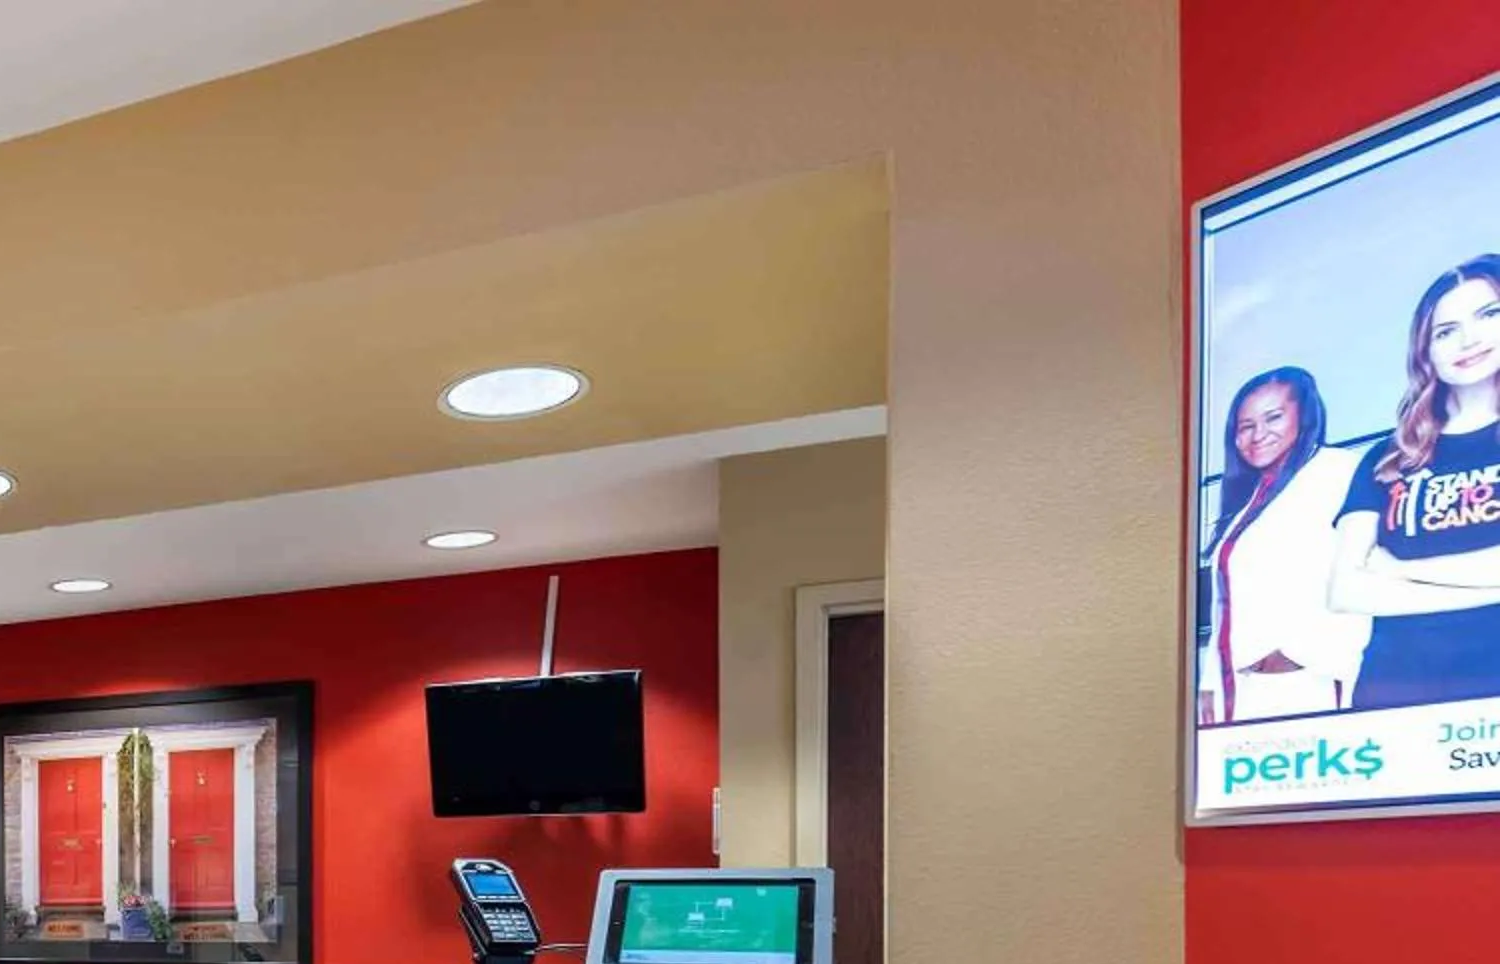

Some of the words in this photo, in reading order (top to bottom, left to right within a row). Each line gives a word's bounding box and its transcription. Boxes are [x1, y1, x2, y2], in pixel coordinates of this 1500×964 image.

[1424, 484, 1460, 512] UP
[1458, 485, 1494, 508] TO
[1223, 737, 1383, 795] perk$
